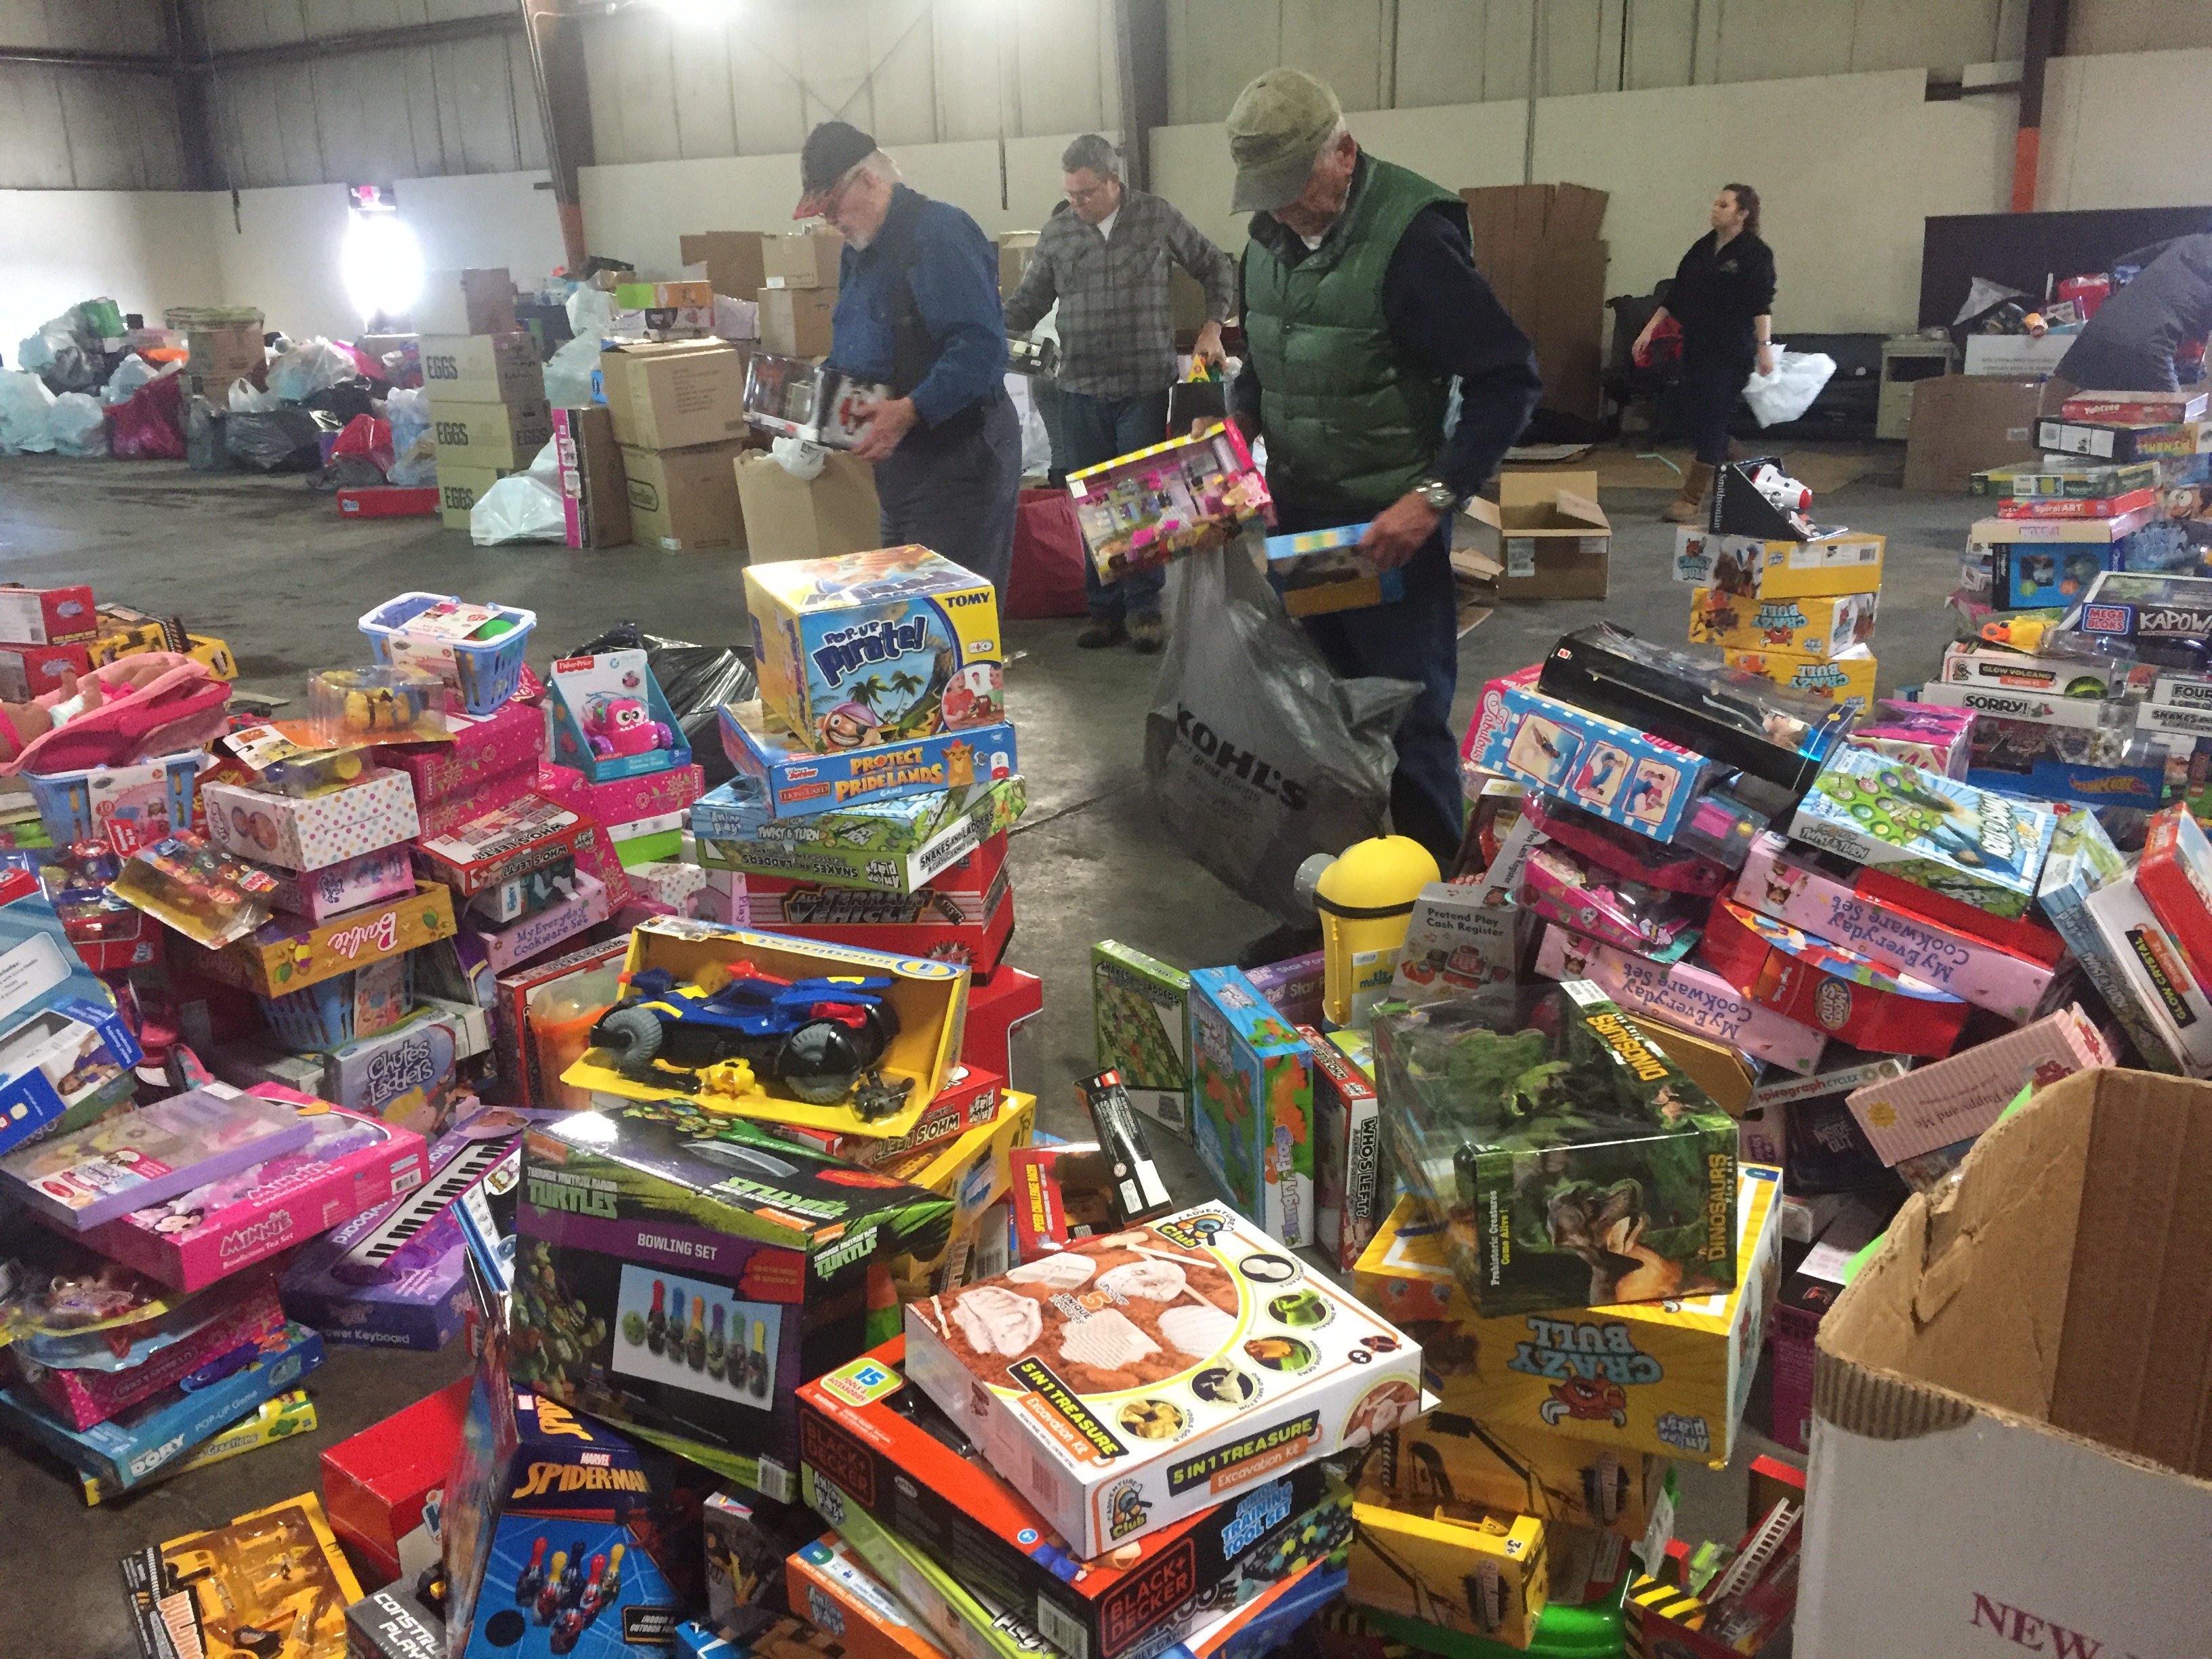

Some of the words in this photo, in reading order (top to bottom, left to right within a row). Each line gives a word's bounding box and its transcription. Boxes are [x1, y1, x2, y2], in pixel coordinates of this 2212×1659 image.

[426, 356, 457, 380] EGGS
[436, 422, 468, 446] EGGS
[444, 487, 474, 510] EGGS
[1713, 474, 1727, 531] Smithsonian
[945, 592, 991, 608] TOMY
[1760, 603, 1799, 616] BULL
[2089, 609, 2125, 620] MEGA
[824, 621, 880, 645] POP-UP
[1751, 613, 1809, 628] CRAZY
[2089, 619, 2125, 631] BLOKS
[1789, 672, 1850, 689] CRAZY
[1797, 663, 1839, 678] BULL
[1965, 696, 2028, 717] SORRY!
[2153, 710, 2195, 722] SNAKES
[1471, 692, 1510, 766] Fabulous
[851, 747, 924, 776] PROTECT
[1176, 701, 1308, 811] KOHL'S
[835, 773, 888, 802] PRIDE
[887, 763, 944, 790] LANDS
[880, 786, 903, 798] GAME
[518, 823, 567, 847] WHO'S
[758, 825, 785, 840] TWIST
[794, 827, 820, 842] TURN
[921, 841, 950, 867] SNAKES
[962, 811, 995, 836] LADDERS
[1801, 827, 1831, 846] TWIST
[1839, 841, 1870, 859] TURN
[501, 856, 533, 878] LEFT?
[534, 844, 567, 864] WHO'S
[743, 853, 798, 869] LADDERS
[813, 861, 860, 878] SNAKES
[788, 903, 915, 924] VEHICLE
[1427, 907, 1471, 922] Pretend
[1475, 915, 1500, 928] Play
[1830, 894, 1864, 924] Set
[329, 910, 398, 960] Barbie
[514, 927, 569, 958] Cookware
[570, 915, 589, 932] Set
[517, 930, 535, 944] My
[534, 905, 586, 937] Everyday
[1426, 918, 1454, 930] Cash
[1456, 922, 1504, 938] Register
[1865, 907, 1970, 969] Cookware
[1826, 909, 1921, 974] Everyday
[1622, 962, 1648, 982] Set
[1922, 959, 1954, 983] My
[2137, 936, 2168, 989] CRYSTAL
[1101, 963, 1132, 980] SNAKES
[1143, 979, 1180, 1006] LADDERS
[1290, 981, 1315, 998] Star
[1650, 971, 1753, 1023] Cookware
[1622, 973, 1707, 1028] Everyday
[1822, 983, 1835, 1021] SAND
[1835, 991, 1848, 1023] MOON
[2163, 987, 2187, 1020] GLOW
[1706, 1015, 1740, 1040] My
[368, 1039, 430, 1080] Chutes
[1586, 1014, 1668, 1080] DINOSAURS
[369, 1063, 434, 1106] Ladders
[1759, 1079, 1826, 1103] spirograph
[1937, 1103, 1960, 1123] and
[1962, 1093, 2002, 1116] Puppy
[916, 1113, 960, 1145] WHO'S
[1913, 1113, 1936, 1130] Me
[1359, 1118, 1377, 1170] WHO'S
[527, 1180, 618, 1219] TURTLES
[724, 1176, 849, 1217] TURTLES
[1357, 1172, 1376, 1218] LEFT?
[1488, 1190, 1498, 1229] Creatures
[1706, 1153, 1727, 1262] DINOSAURS
[220, 1209, 293, 1257] MINNIE
[1160, 1224, 1197, 1249] Club
[1500, 1212, 1510, 1235] Alive
[266, 1239, 281, 1252] Tea
[280, 1232, 294, 1245] Set
[637, 1232, 693, 1256] BOWLING
[694, 1242, 718, 1261] SET
[1500, 1237, 1510, 1265] Come
[1490, 1229, 1499, 1286] Prehistoric
[1061, 1292, 1094, 1320] UNIQUE
[1078, 1290, 1113, 1309] 5
[321, 1330, 352, 1340] ower
[354, 1329, 411, 1345] Keyboard
[1528, 1317, 1636, 1355] BULL
[854, 1367, 887, 1387] 15
[1507, 1343, 1663, 1385] CRAZY
[842, 1376, 861, 1393] TOOLS
[1021, 1363, 1034, 1373] 5
[1052, 1388, 1120, 1455] TREASURE
[1029, 1397, 1075, 1444] Excavation
[1072, 1437, 1090, 1456] Kit
[131, 1433, 185, 1477] DORY
[207, 1433, 260, 1456] Creations
[1173, 1469, 1184, 1485] 5
[1187, 1461, 1206, 1481] IN
[1208, 1458, 1216, 1473] 1
[1222, 1418, 1313, 1467] TREASURE
[1659, 1431, 1711, 1453] Anker
[580, 1452, 611, 1467] MARVEL
[1217, 1452, 1283, 1487] Excavation
[1285, 1443, 1300, 1458] Kit
[512, 1461, 652, 1499] SPIDER-MAN
[1221, 1482, 1294, 1542] TRAINING
[1111, 1515, 1147, 1540] Club
[1224, 1519, 1265, 1560] TOOL
[1265, 1501, 1292, 1530] SET
[1110, 1559, 1186, 1620] BLACK+
[1110, 1572, 1189, 1645] DECKER
[1971, 1591, 2104, 1659] NEW
